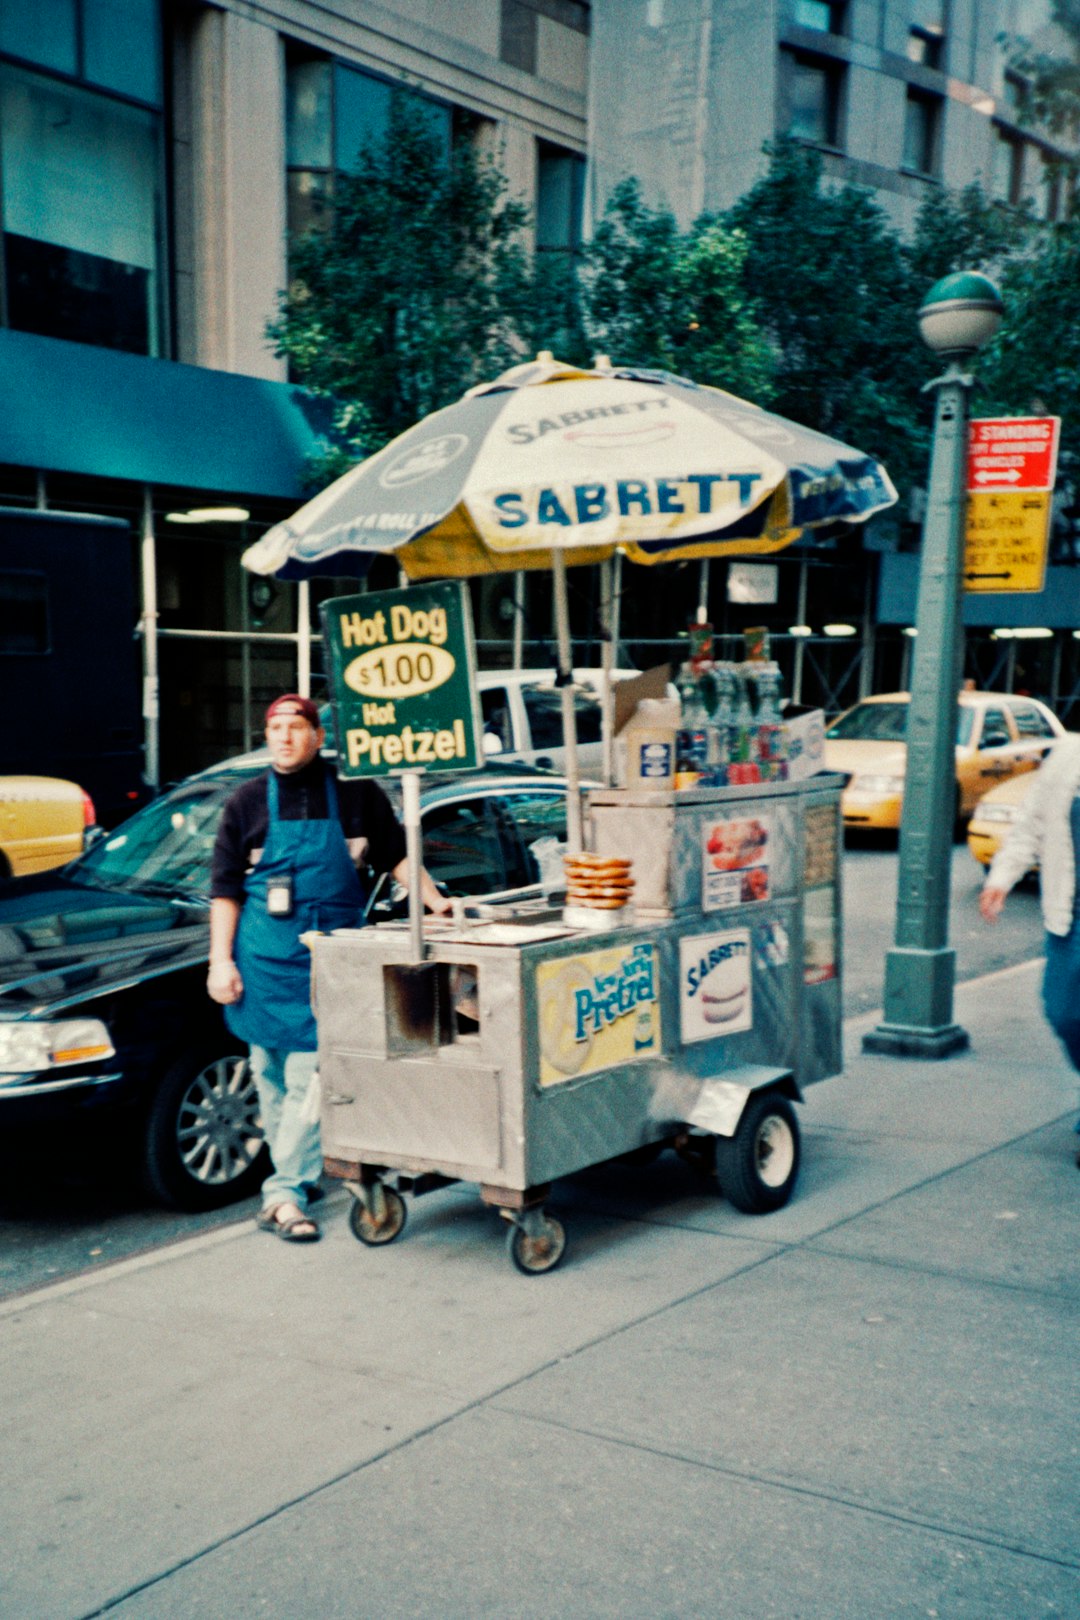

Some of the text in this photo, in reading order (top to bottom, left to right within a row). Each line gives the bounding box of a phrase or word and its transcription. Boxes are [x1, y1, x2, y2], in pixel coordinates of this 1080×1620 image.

[507, 399, 671, 444] SABRETT
[494, 473, 762, 528] SABRETT
[340, 604, 447, 648] Hot Dog
[360, 651, 434, 687] $1.00
[362, 702, 397, 726] Hot
[346, 719, 466, 767] Pretzel
[574, 957, 656, 1039] Pretzel
